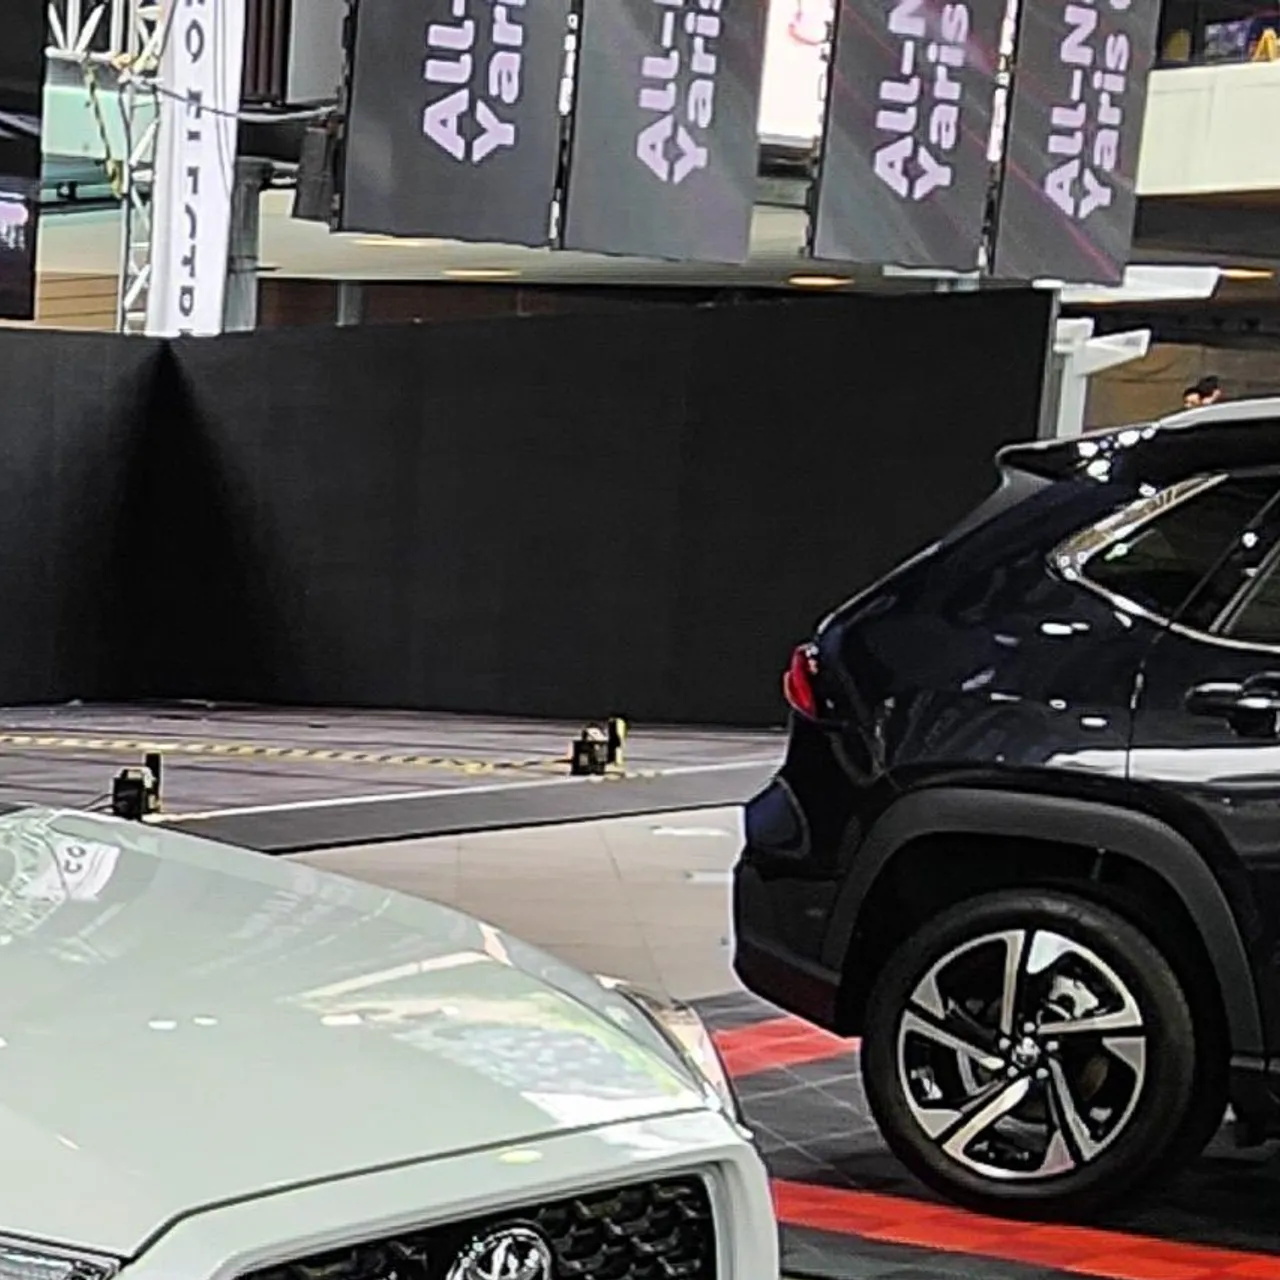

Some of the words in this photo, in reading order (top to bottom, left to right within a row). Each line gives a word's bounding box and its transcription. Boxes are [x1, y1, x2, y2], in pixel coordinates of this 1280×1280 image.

[471, 0, 527, 163] Yar
[637, 0, 683, 182] All-
[912, 3, 970, 201] Yaris
[1044, 0, 1098, 217] All-N
[1077, 33, 1129, 220] Yaris
